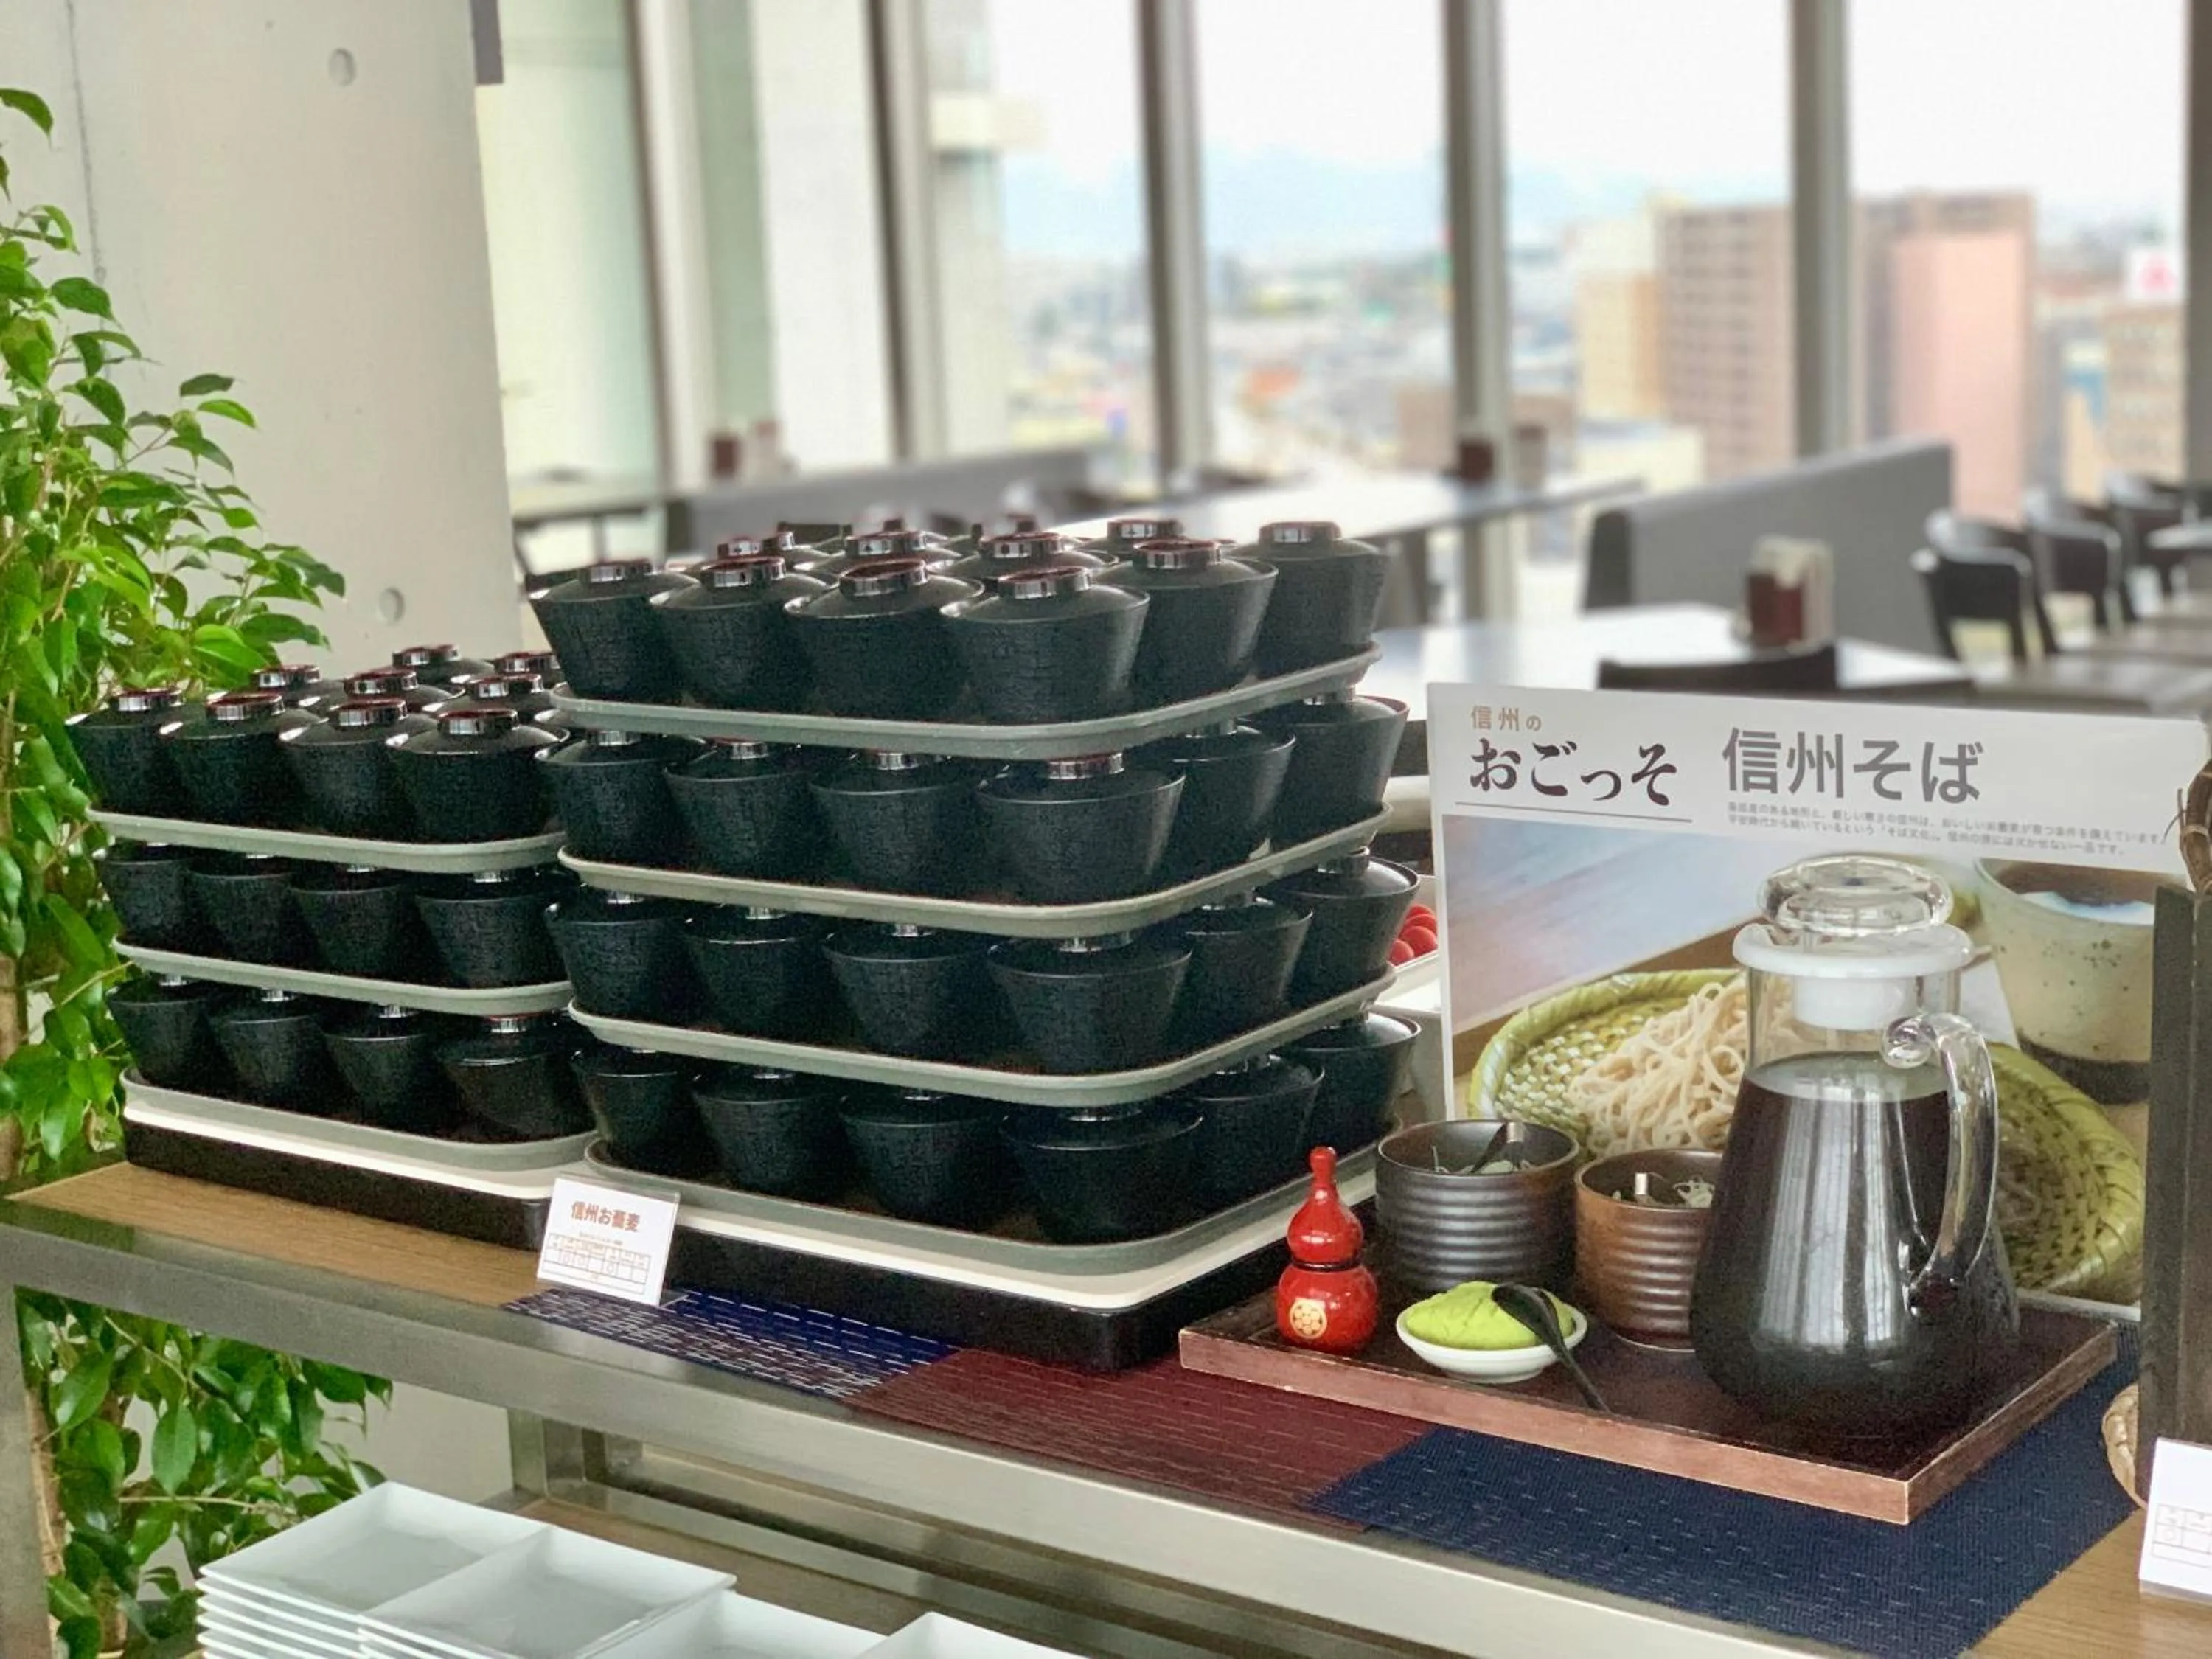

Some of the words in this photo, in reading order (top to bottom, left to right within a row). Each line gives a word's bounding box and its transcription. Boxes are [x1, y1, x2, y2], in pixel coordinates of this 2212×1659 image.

[1470, 706, 1542, 732] 信州の
[1470, 737, 1677, 806] おごっそ
[1722, 728, 1983, 804] 信州そば
